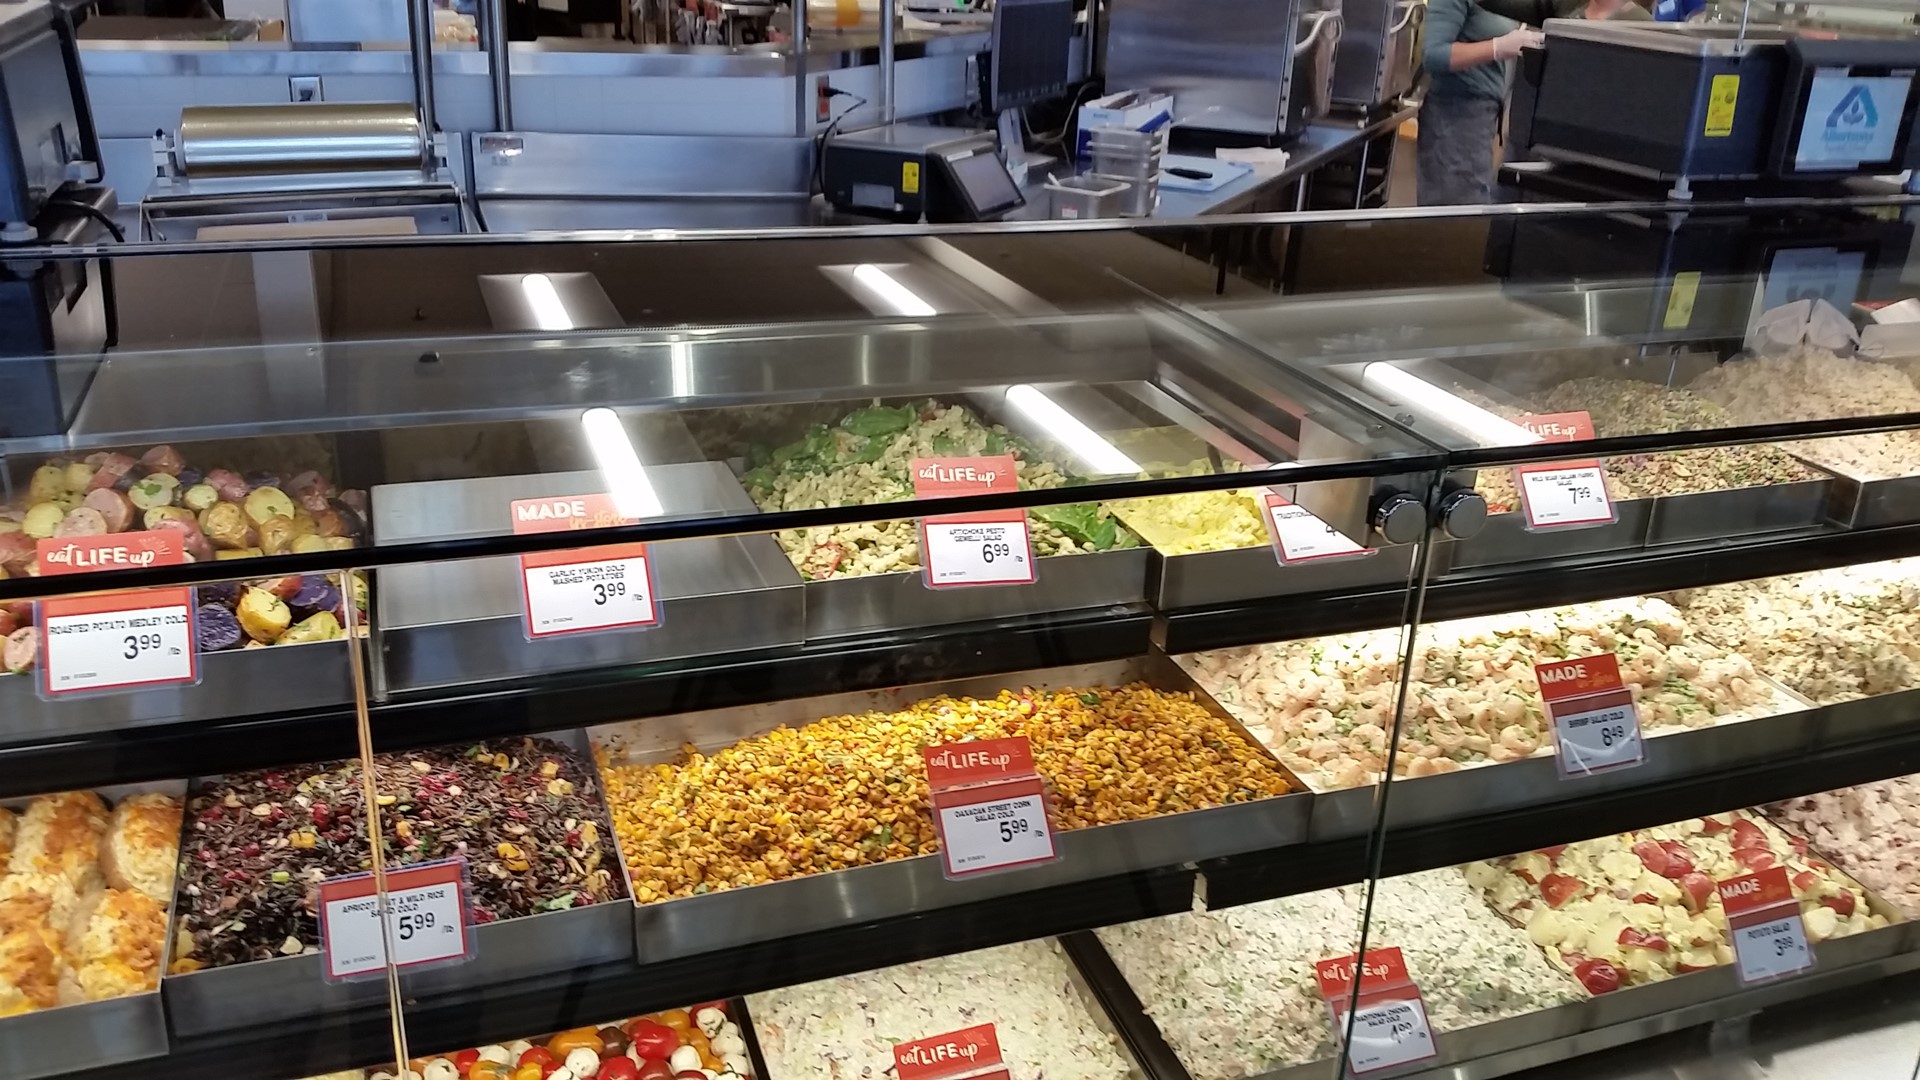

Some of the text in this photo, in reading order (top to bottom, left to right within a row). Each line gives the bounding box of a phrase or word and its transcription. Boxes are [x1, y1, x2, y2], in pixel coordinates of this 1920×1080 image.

[1562, 425, 1577, 442] up
[919, 463, 996, 488] eat LIFE up
[517, 500, 586, 522] MADE
[46, 543, 156, 567] eat LIFE up
[549, 564, 625, 578] GARLIC YUKON GOLD
[552, 572, 624, 585] MASHED POTATOES
[49, 614, 188, 636] ROASTED POTATO MEDLEY COLD
[1540, 664, 1588, 684] MADE
[930, 749, 1010, 772] eat LIFE up
[975, 810, 1015, 822] SALAD COLD
[987, 803, 1012, 813] STREET
[1013, 800, 1031, 809] CORN
[1720, 878, 1761, 899] MADE
[342, 901, 375, 913] APRICOT
[405, 894, 425, 903] WILD
[427, 890, 445, 899] RICE
[398, 903, 418, 913] COLD
[1373, 963, 1389, 982] up
[900, 1042, 978, 1066] eat LIFE up
